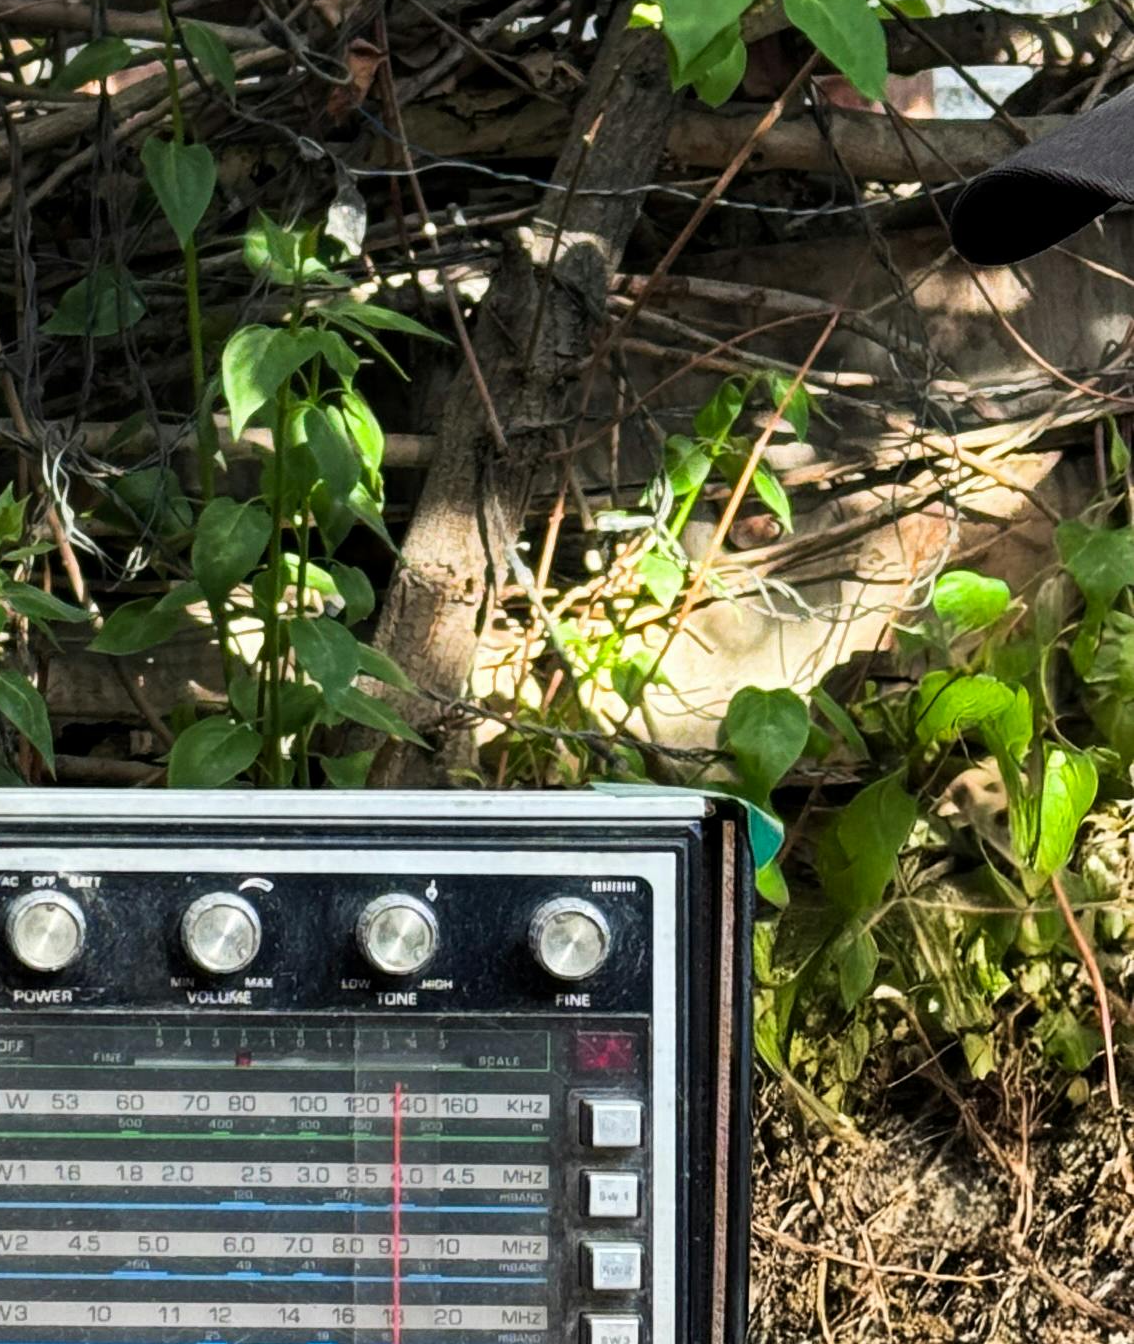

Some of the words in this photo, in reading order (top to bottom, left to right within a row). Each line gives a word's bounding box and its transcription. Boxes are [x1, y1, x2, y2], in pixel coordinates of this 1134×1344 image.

[1, 877, 19, 887] AC
[32, 877, 56, 888] OFF
[69, 877, 102, 888] BATT
[170, 977, 195, 988] MIN
[245, 977, 273, 989] MAX
[341, 979, 371, 989] LOW
[422, 979, 453, 989] HIGH
[13, 990, 72, 1003] POWER
[187, 991, 252, 1004] VOLUME
[376, 992, 418, 1006] TONE
[555, 993, 591, 1007] FINE
[478, 1055, 521, 1067] SCALE
[51, 1093, 79, 1110] 53
[117, 1094, 144, 1111] 60
[183, 1095, 210, 1111] 70
[228, 1095, 257, 1111] 80
[289, 1096, 328, 1112] 100
[344, 1096, 380, 1113] 120
[389, 1097, 427, 1113] 140
[440, 1098, 479, 1114] 160
[507, 1099, 543, 1115] KHz
[118, 1119, 143, 1128] 500
[208, 1119, 233, 1129] 400
[297, 1120, 321, 1130] 300
[161, 1165, 194, 1182] 2.0
[241, 1166, 273, 1183] 2.5
[297, 1167, 330, 1184] 3.0
[347, 1167, 378, 1184] 3.5
[442, 1168, 475, 1184] 4.5
[503, 1169, 543, 1184] MHz
[68, 1236, 101, 1252] 4.5
[137, 1235, 170, 1252] 5.0
[223, 1236, 256, 1253] 6.0
[284, 1237, 314, 1254] 7.0
[332, 1237, 364, 1254] 8.0
[436, 1238, 460, 1255] 10
[502, 1240, 542, 1255] MHz
[87, 1306, 112, 1322] 10
[158, 1306, 180, 1323] 11
[208, 1307, 232, 1323] 12
[277, 1307, 301, 1323] 14
[332, 1307, 355, 1324] 16
[433, 1308, 463, 1325] 20
[501, 1309, 541, 1325] MHz
